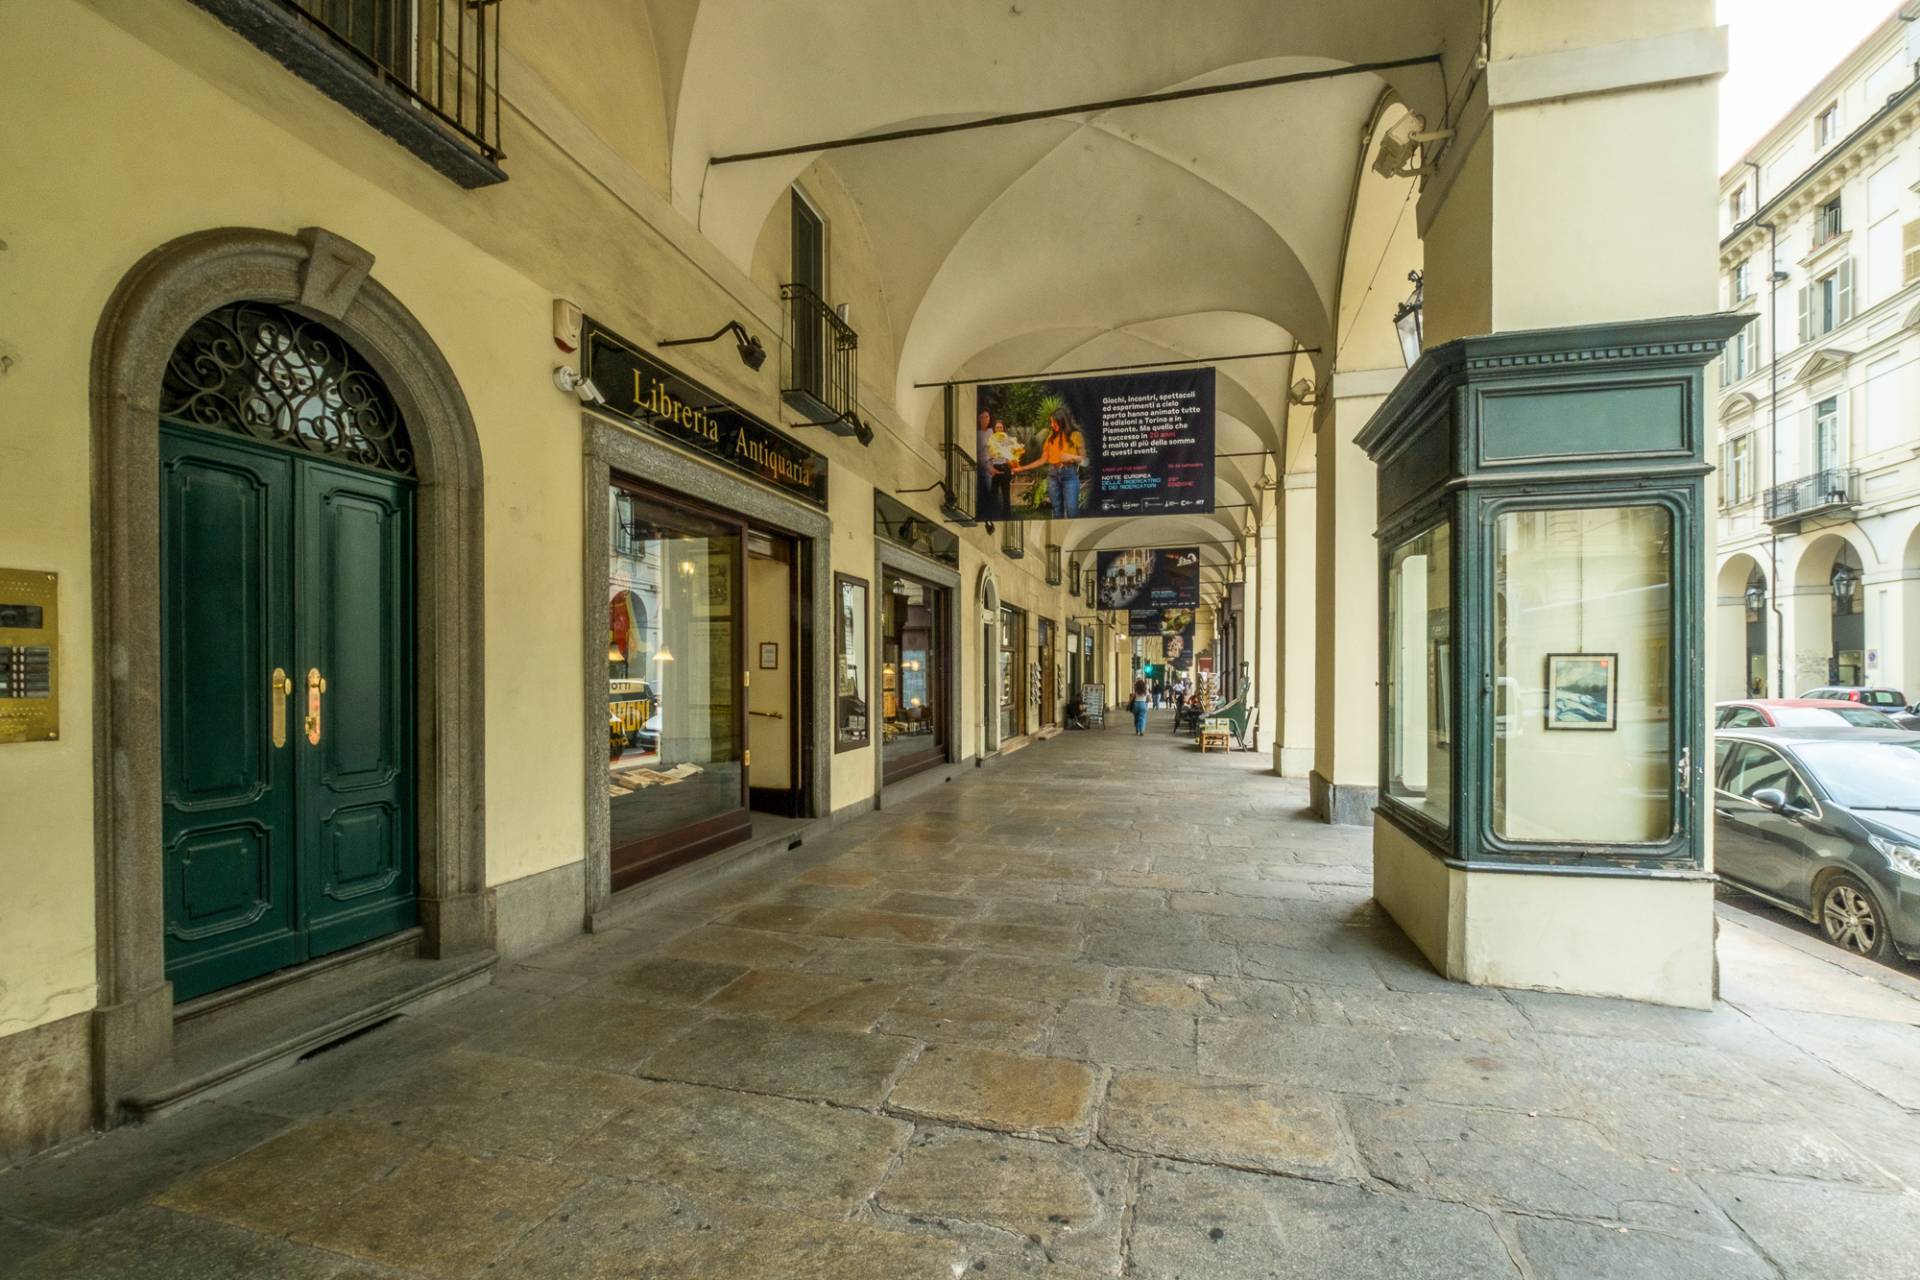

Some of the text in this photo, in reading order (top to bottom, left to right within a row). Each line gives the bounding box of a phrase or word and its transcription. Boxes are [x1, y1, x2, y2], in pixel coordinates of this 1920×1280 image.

[1160, 392, 1196, 400] spettacoli
[1113, 403, 1154, 412] esperimenti
[1102, 412, 1126, 420] aperto
[633, 368, 811, 488] Libreria Antiquaria
[1152, 424, 1174, 432] quello
[1110, 448, 1132, 457] questi
